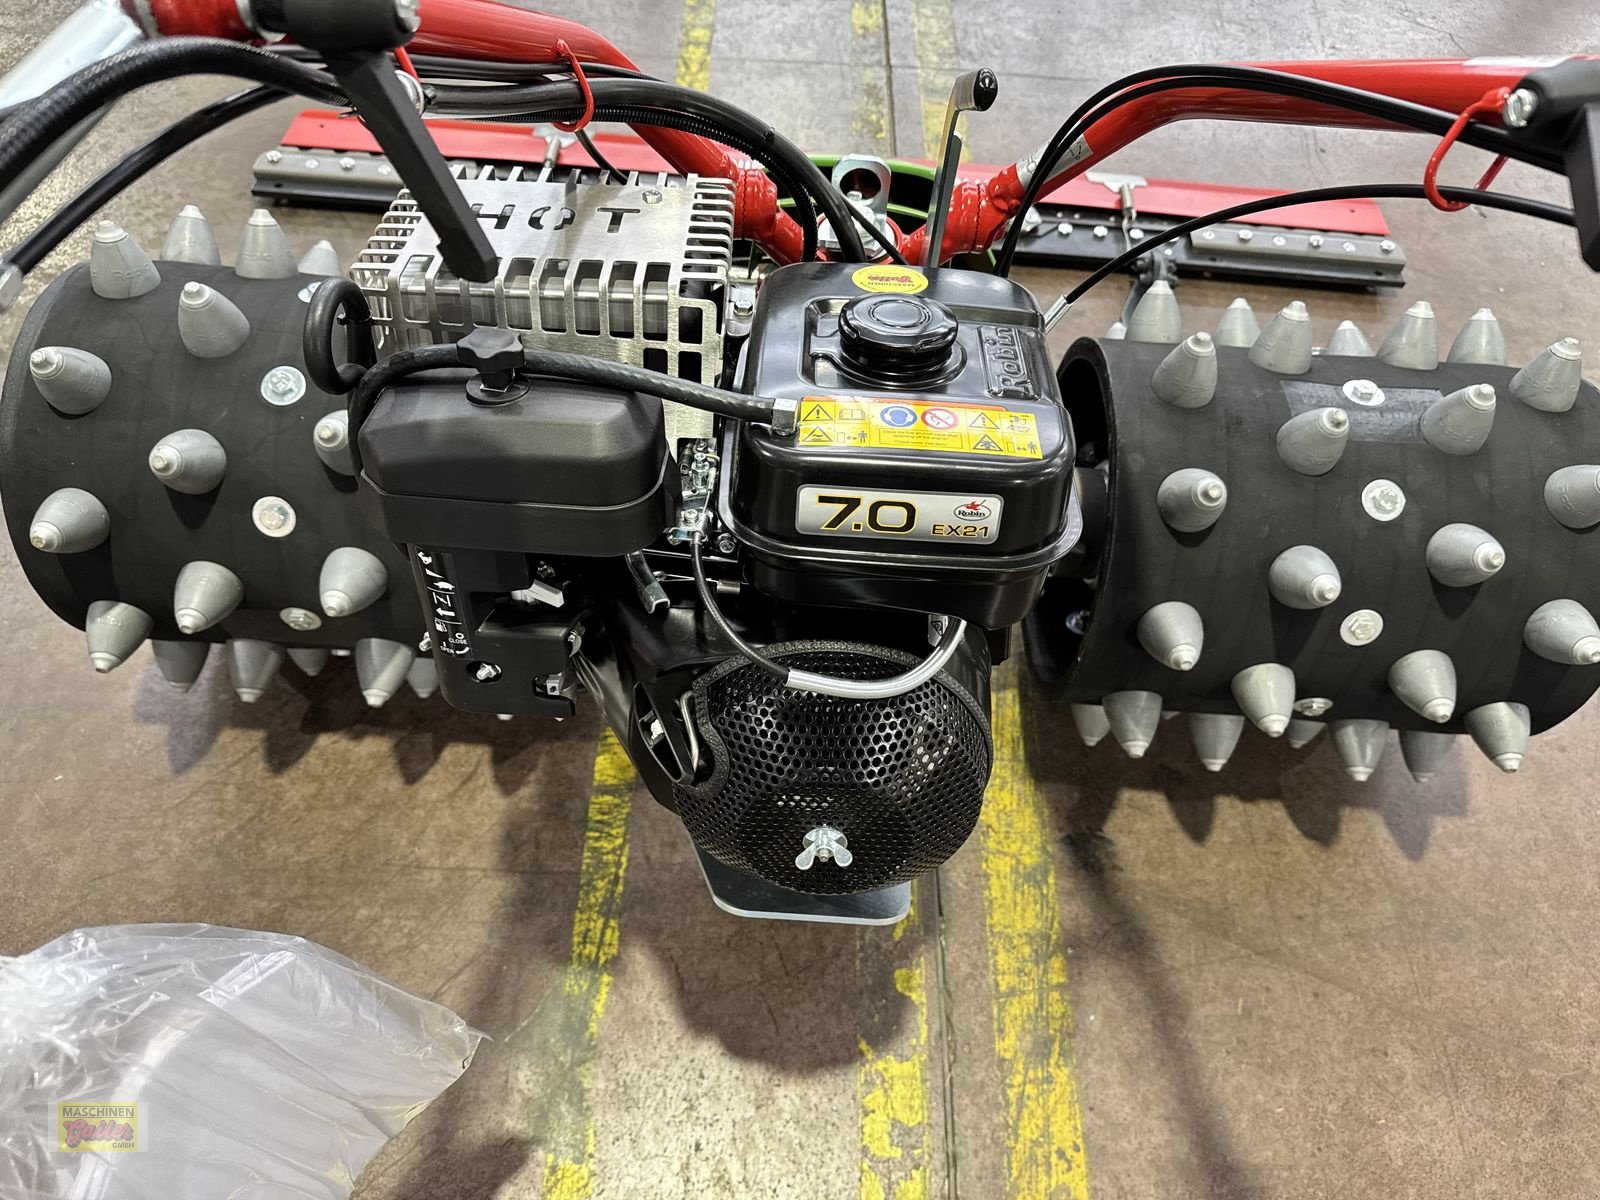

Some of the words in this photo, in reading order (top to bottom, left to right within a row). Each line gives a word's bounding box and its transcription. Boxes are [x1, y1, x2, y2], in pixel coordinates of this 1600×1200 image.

[471, 203, 641, 234] HOT
[985, 327, 1032, 397] Robin
[817, 494, 917, 535] 7.0
[957, 509, 986, 518] Robin
[931, 524, 990, 537] EX21
[448, 637, 468, 645] CLOSE
[440, 645, 455, 654] OPEN
